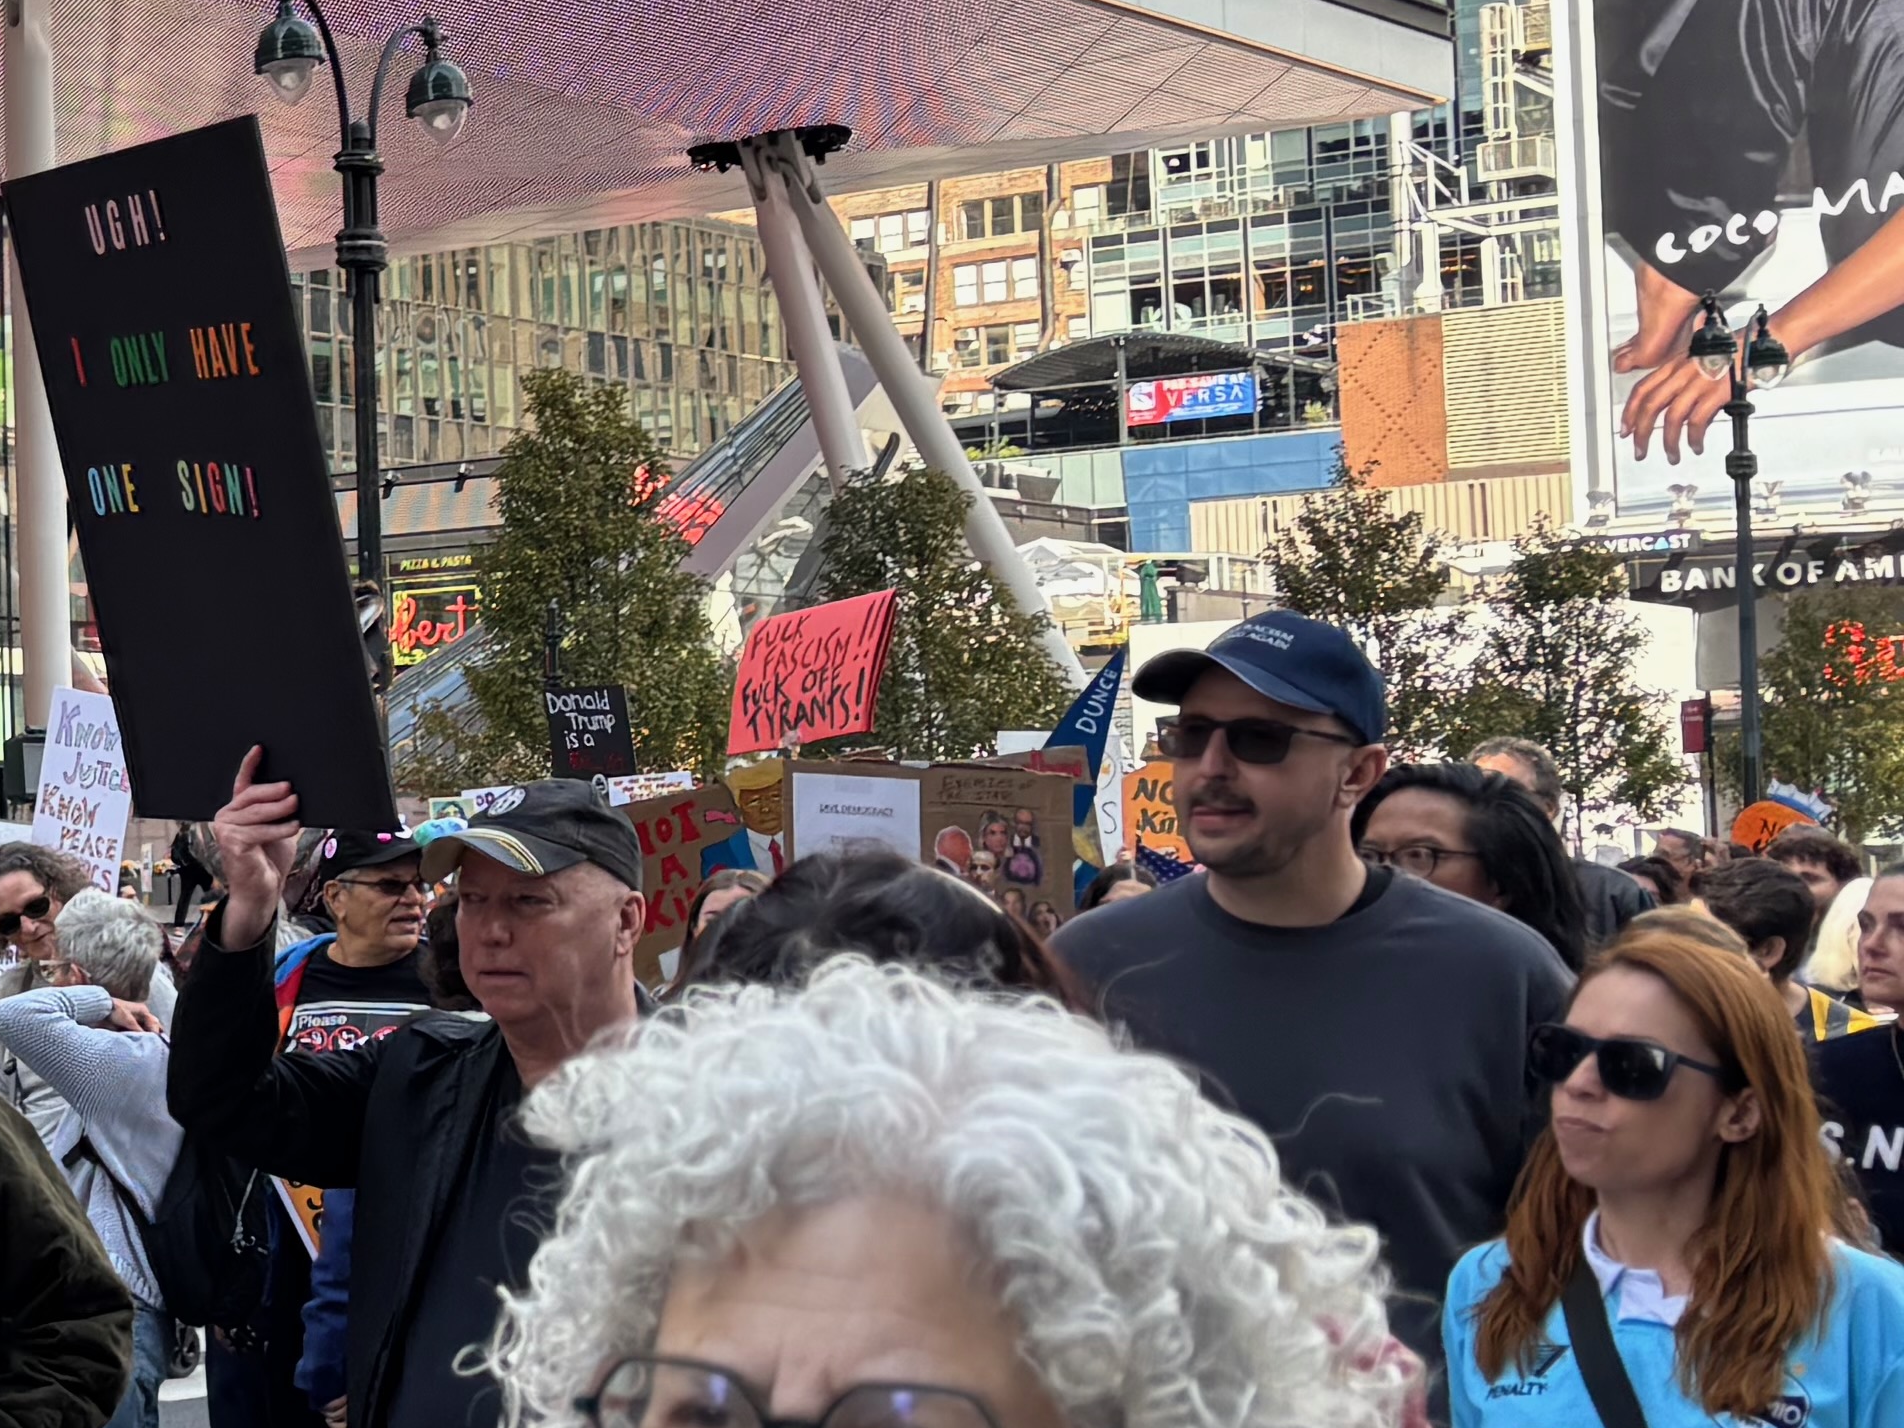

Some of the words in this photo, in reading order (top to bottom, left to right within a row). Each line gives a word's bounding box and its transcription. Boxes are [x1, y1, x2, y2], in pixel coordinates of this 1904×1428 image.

[84, 188, 170, 256] UGH!
[1655, 209, 1779, 264] COCO
[70, 337, 88, 389] I
[109, 329, 170, 390] ONLY
[190, 321, 263, 383] HAVE
[1165, 384, 1245, 407] VERSA
[87, 462, 140, 519] ONE
[176, 459, 264, 521] SIGN!
[1777, 560, 1824, 586] OF
[1835, 554, 1904, 582] AM
[750, 613, 812, 661] FUCK
[544, 689, 611, 715] Donald
[742, 672, 793, 717] FUCK
[801, 664, 842, 694] OFF
[1075, 667, 1119, 736] DUNCE
[563, 730, 580, 750] is
[583, 732, 596, 748] a
[564, 712, 616, 734] Trump
[660, 852, 690, 886] A
[1484, 1380, 1546, 1402] PENALTY
